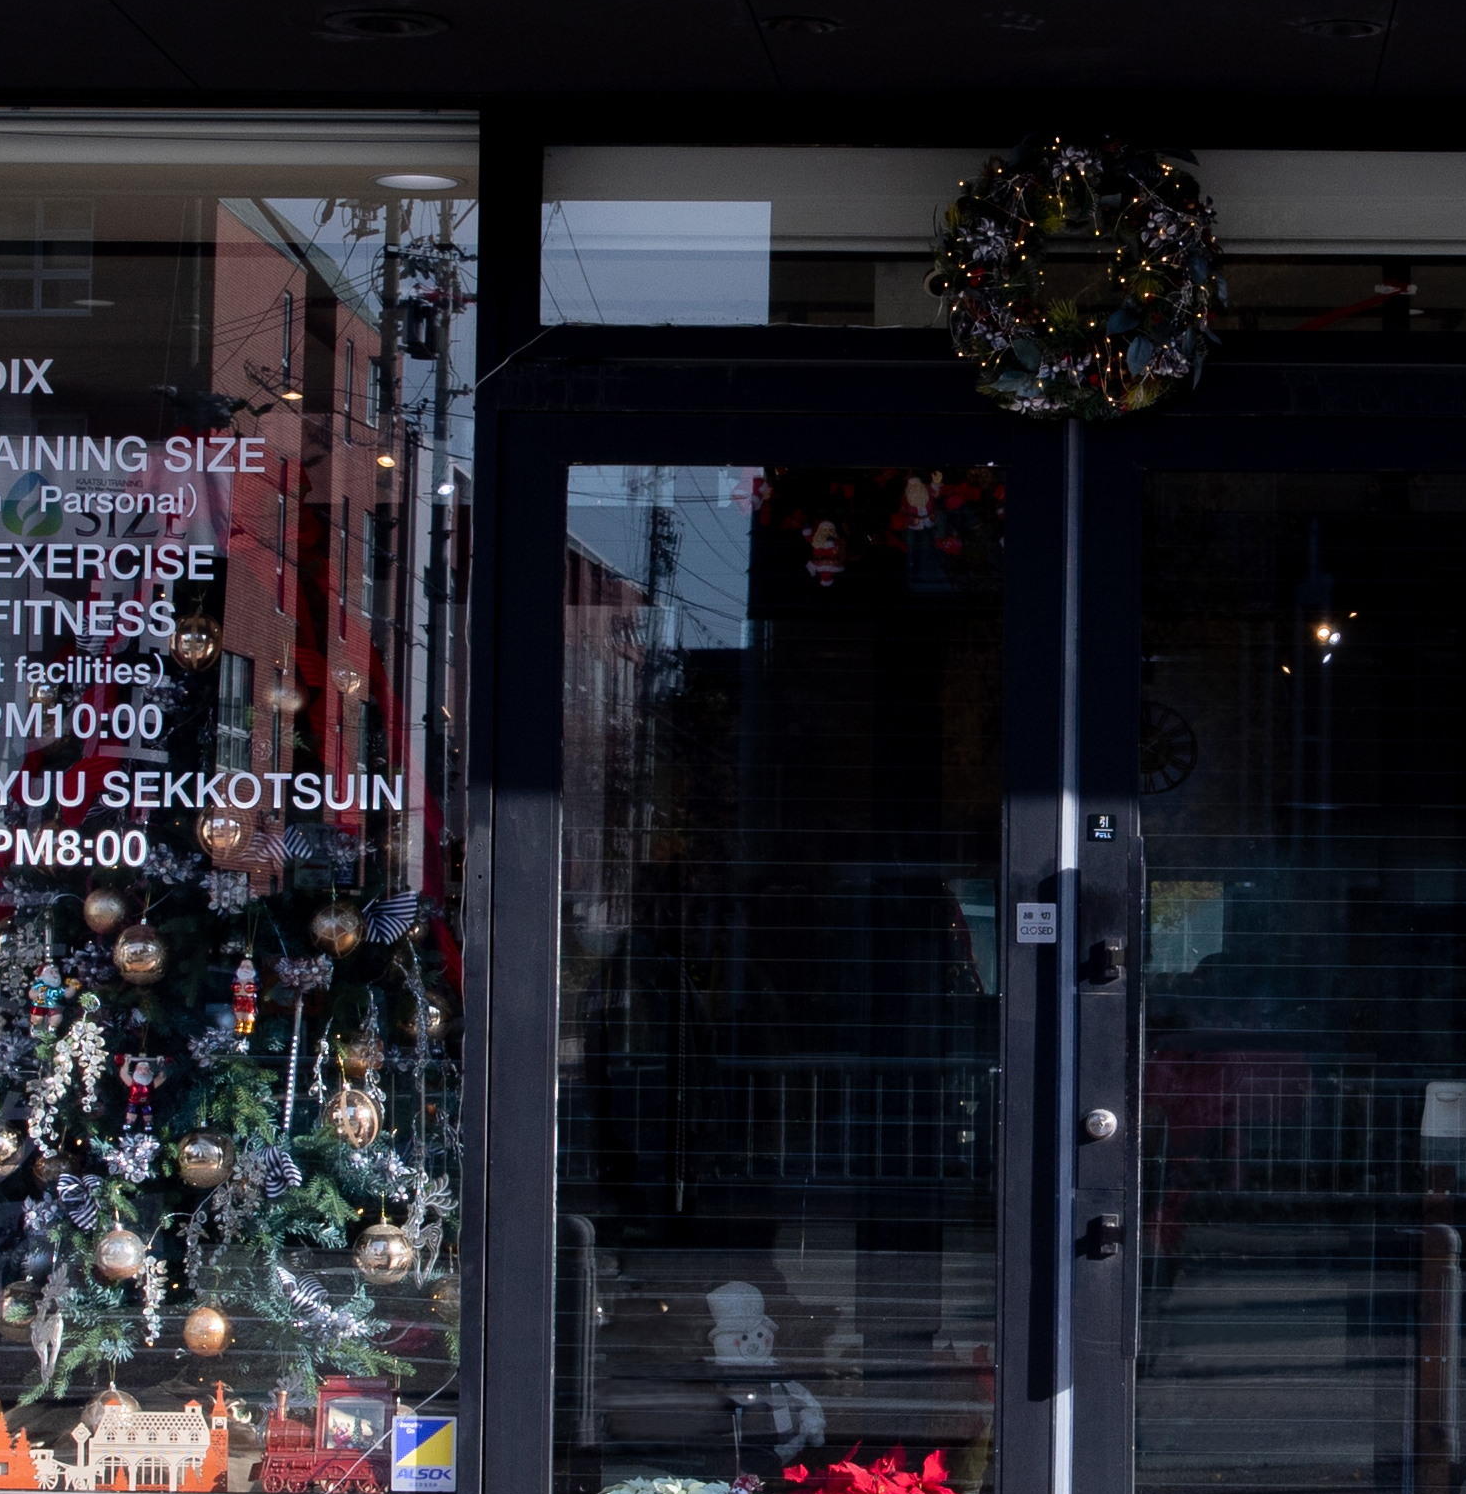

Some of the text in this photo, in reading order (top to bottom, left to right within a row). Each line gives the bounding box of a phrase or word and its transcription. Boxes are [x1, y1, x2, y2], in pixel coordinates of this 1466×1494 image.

[163, 435, 267, 474] SIZE
[40, 483, 197, 517] Parsonal)
[14, 654, 166, 689] facilities)
[102, 770, 405, 812] SEKKOTSUIN
[1099, 815, 1109, 828] 引
[1019, 925, 1054, 936] CLOSED
[395, 1468, 453, 1481] ALSOK
